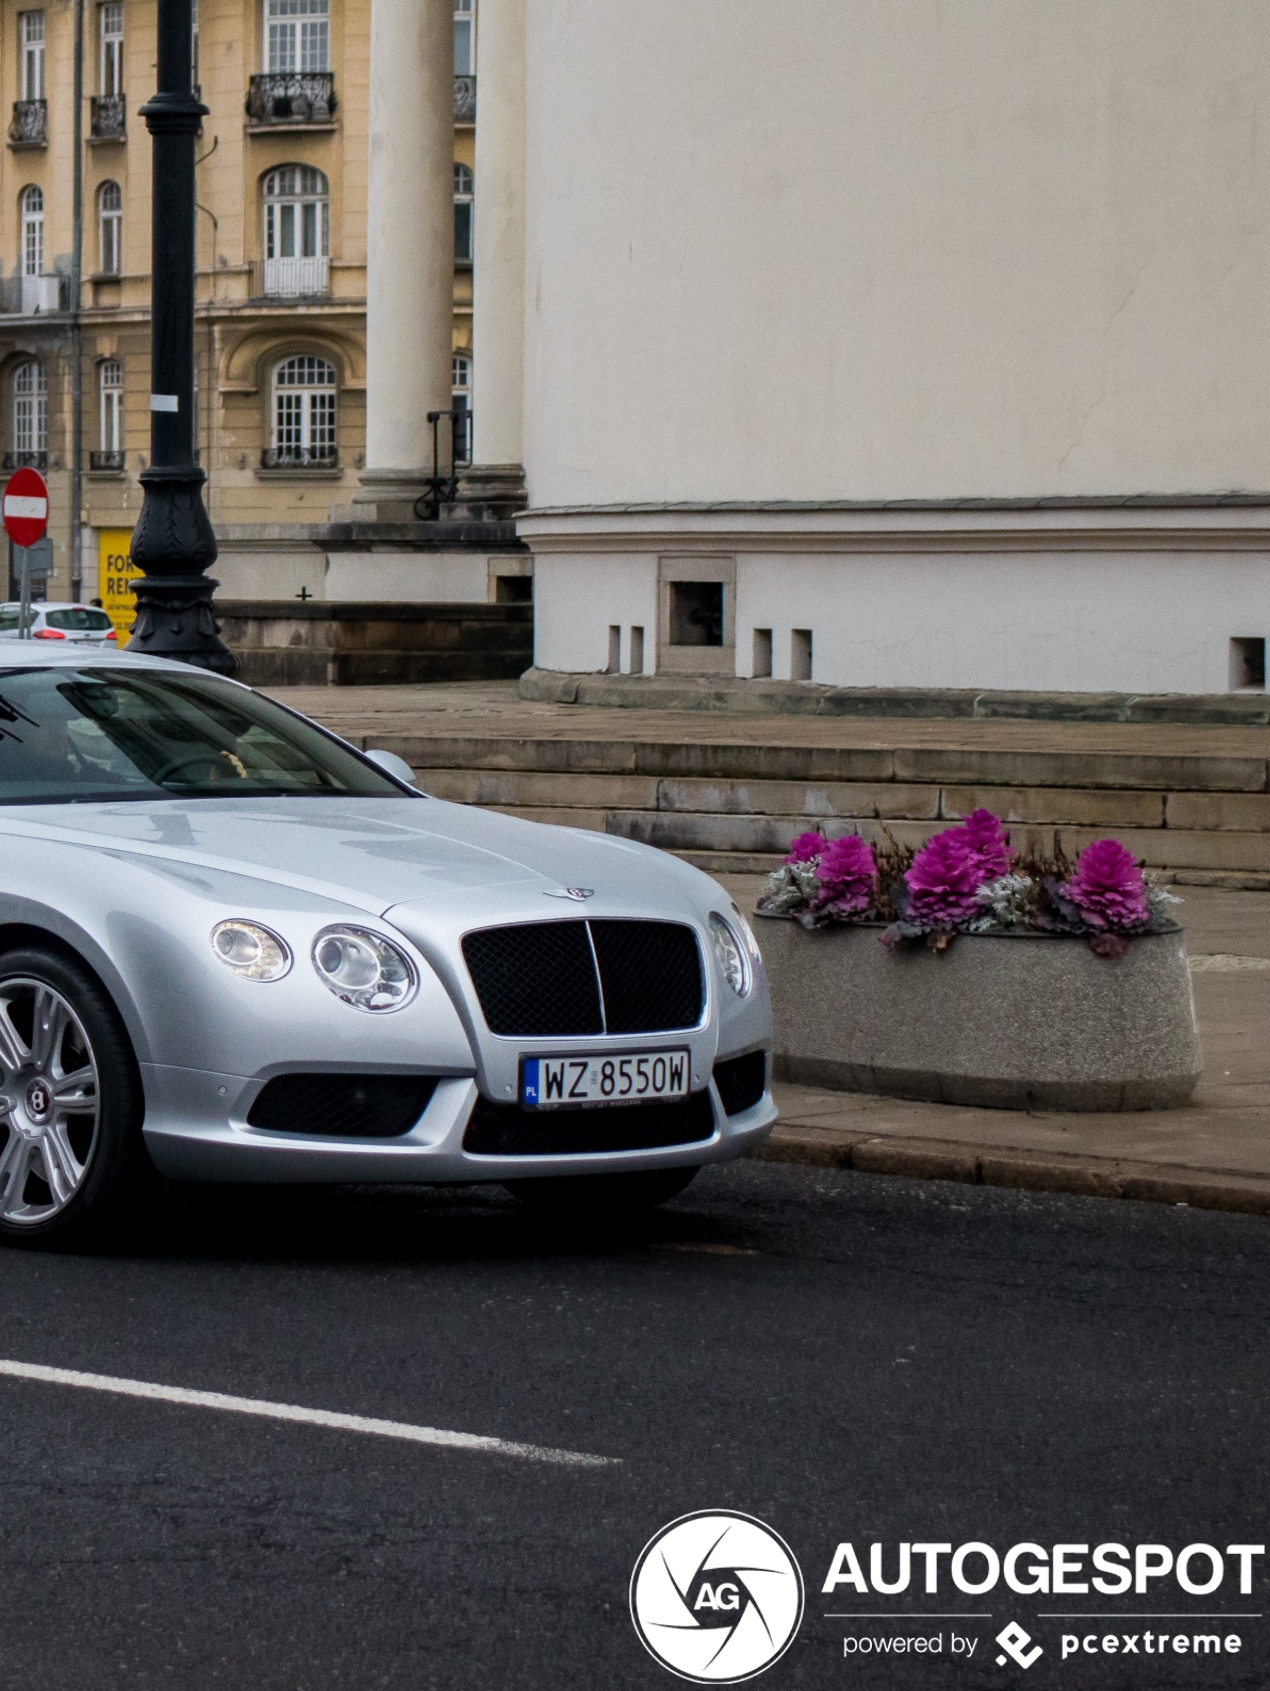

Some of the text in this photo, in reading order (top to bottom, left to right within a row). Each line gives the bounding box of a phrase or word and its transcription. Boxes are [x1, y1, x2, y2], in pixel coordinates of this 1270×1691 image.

[107, 554, 134, 573] FOR
[545, 1055, 684, 1099] WZ 8550W
[525, 1086, 537, 1097] PL
